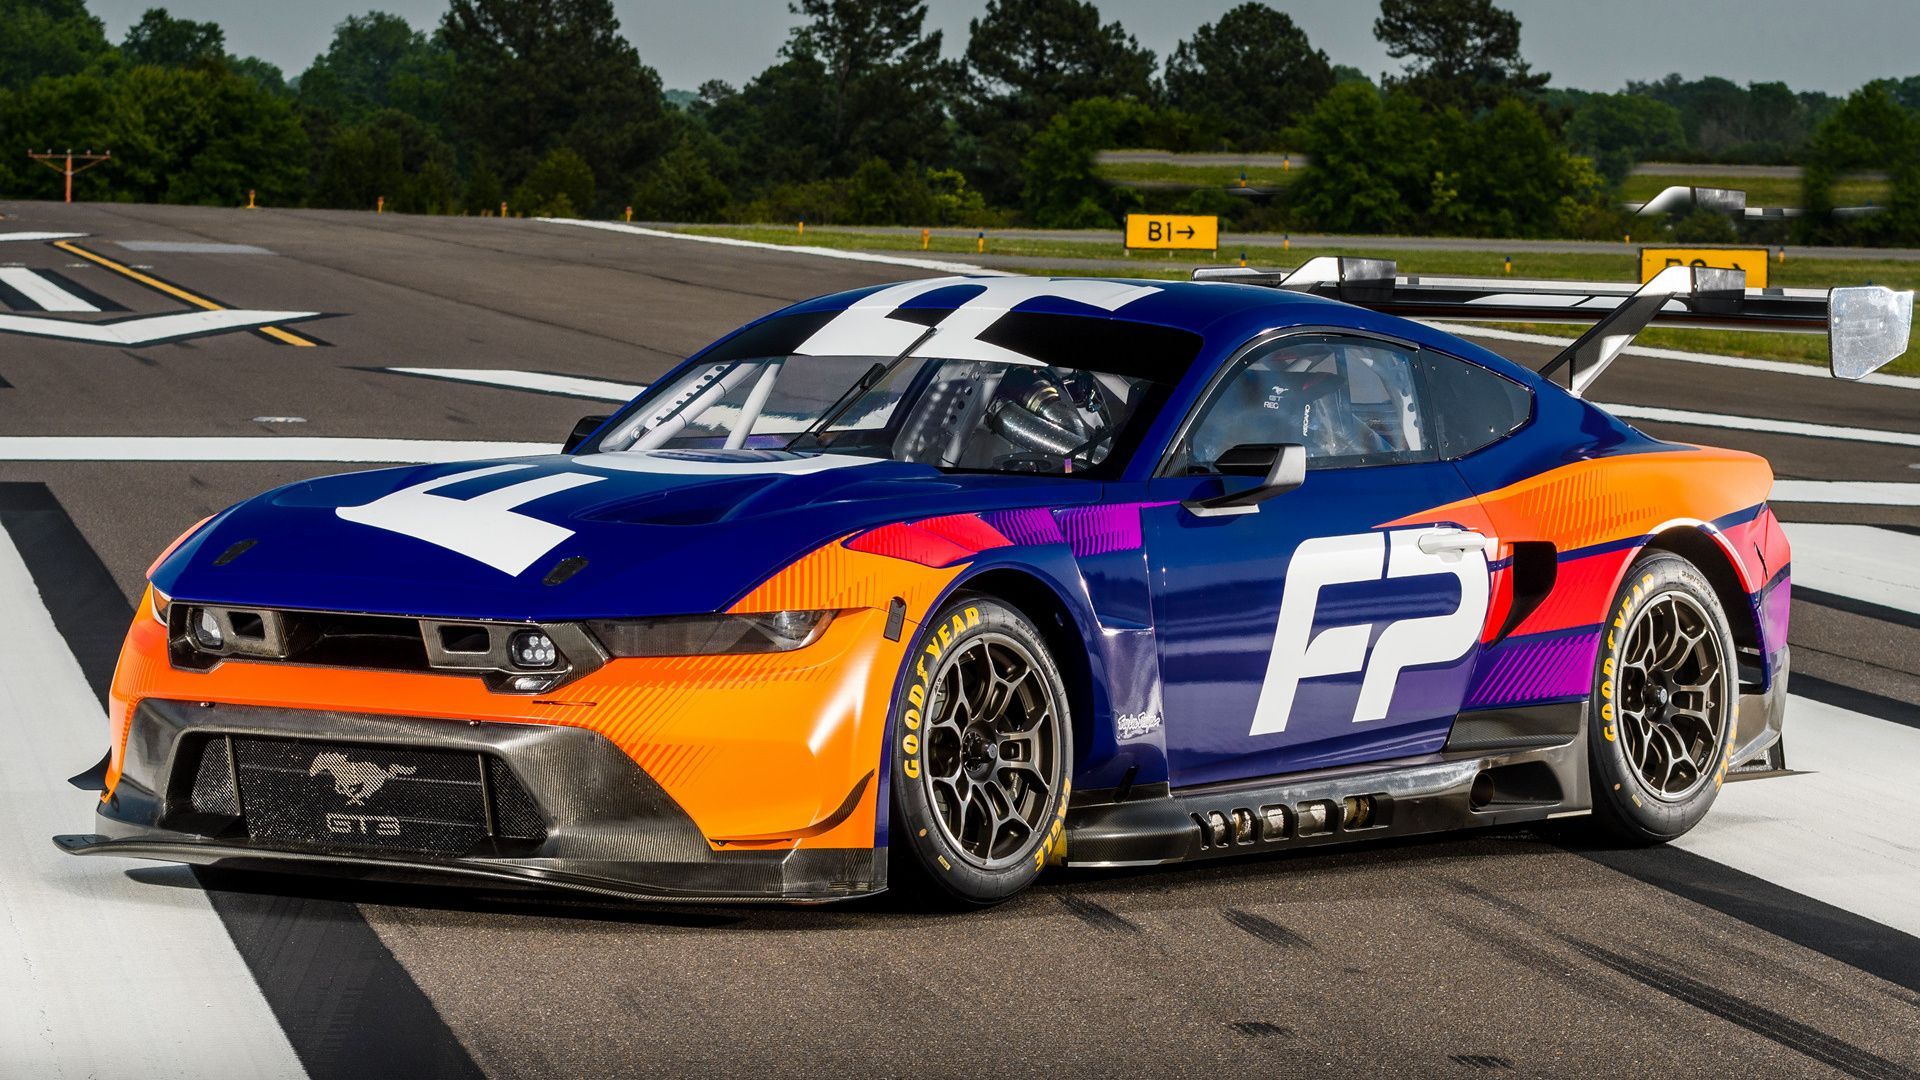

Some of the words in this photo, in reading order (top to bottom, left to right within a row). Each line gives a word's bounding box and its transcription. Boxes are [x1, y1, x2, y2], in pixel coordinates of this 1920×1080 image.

[1148, 221, 1171, 242] B1
[903, 606, 980, 779] GOODYEAR
[1249, 527, 1489, 736] FP
[1601, 573, 1655, 742] GOODYEAR
[325, 813, 401, 836] GT3
